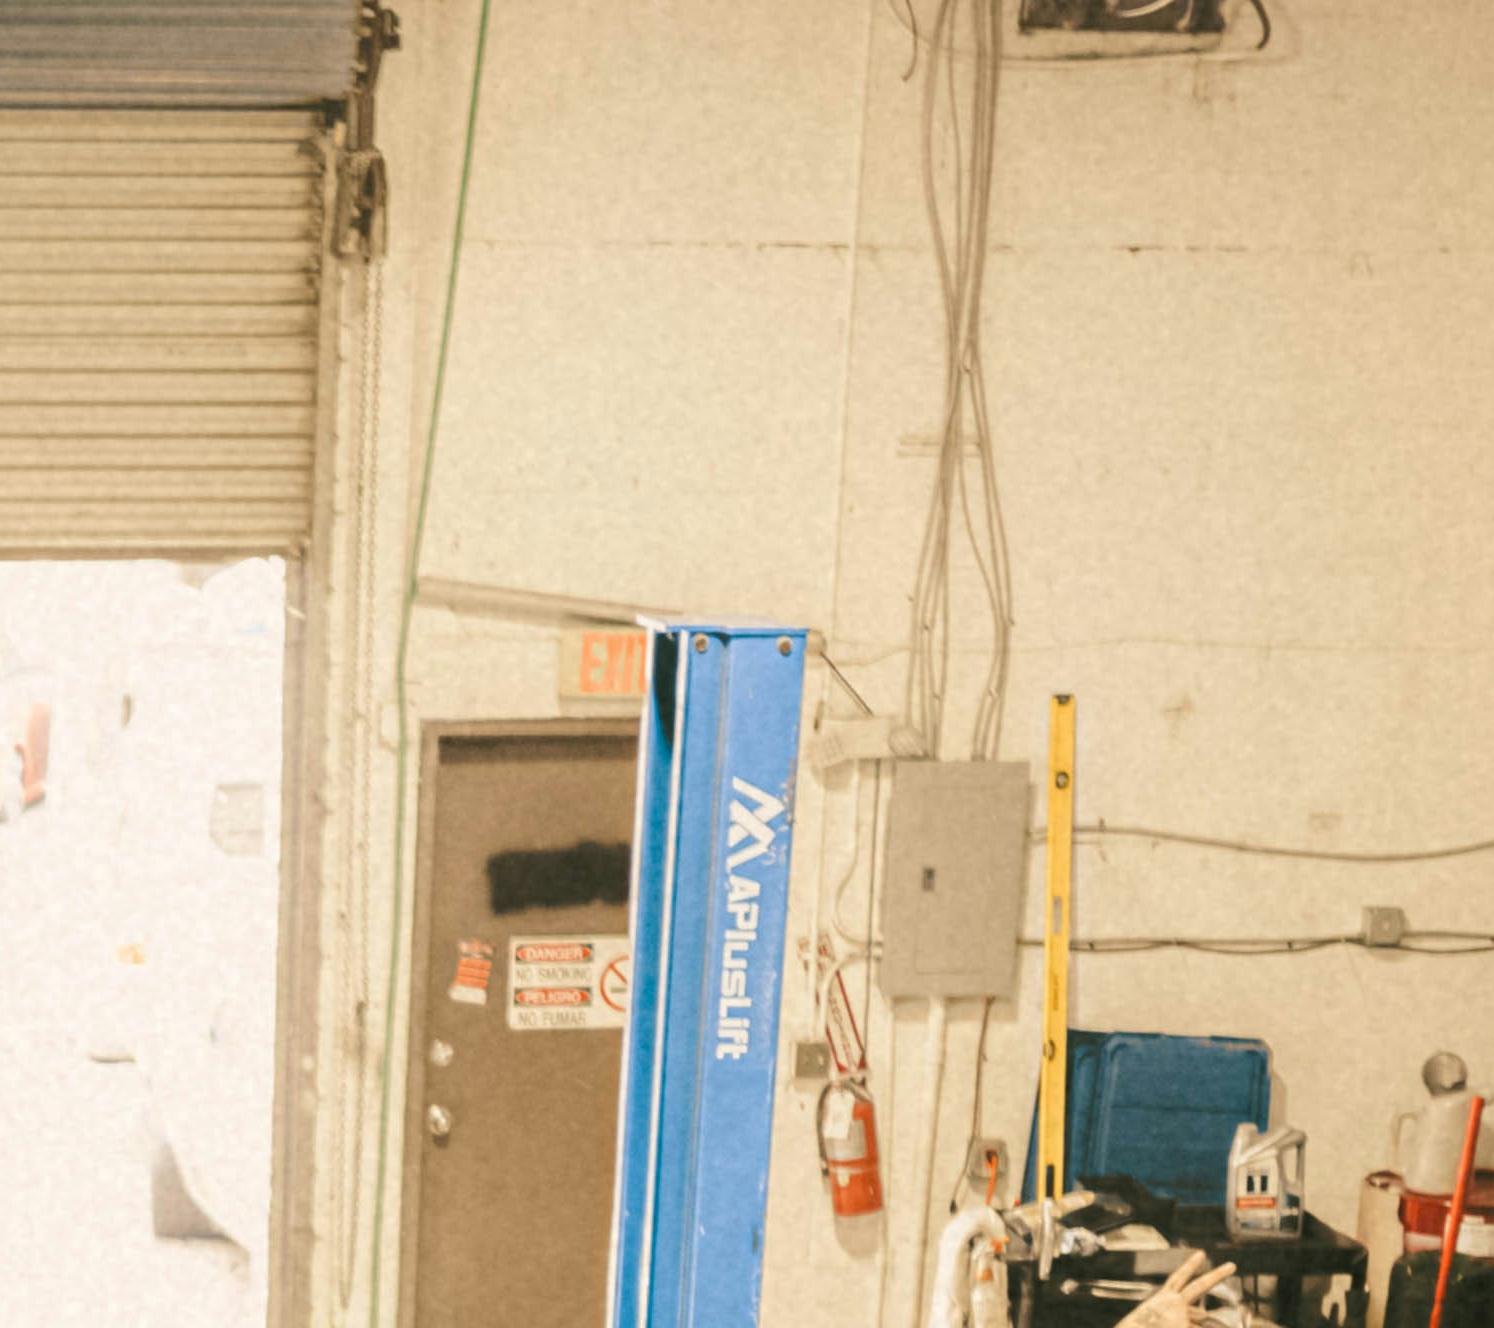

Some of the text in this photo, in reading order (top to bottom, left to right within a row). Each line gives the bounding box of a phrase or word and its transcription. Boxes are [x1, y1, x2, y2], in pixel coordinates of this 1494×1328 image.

[526, 946, 583, 961] DANGER
[517, 967, 592, 981] NO SMOKING
[525, 990, 582, 1005] PELIGRO
[519, 1011, 587, 1025] NO FUMAR
